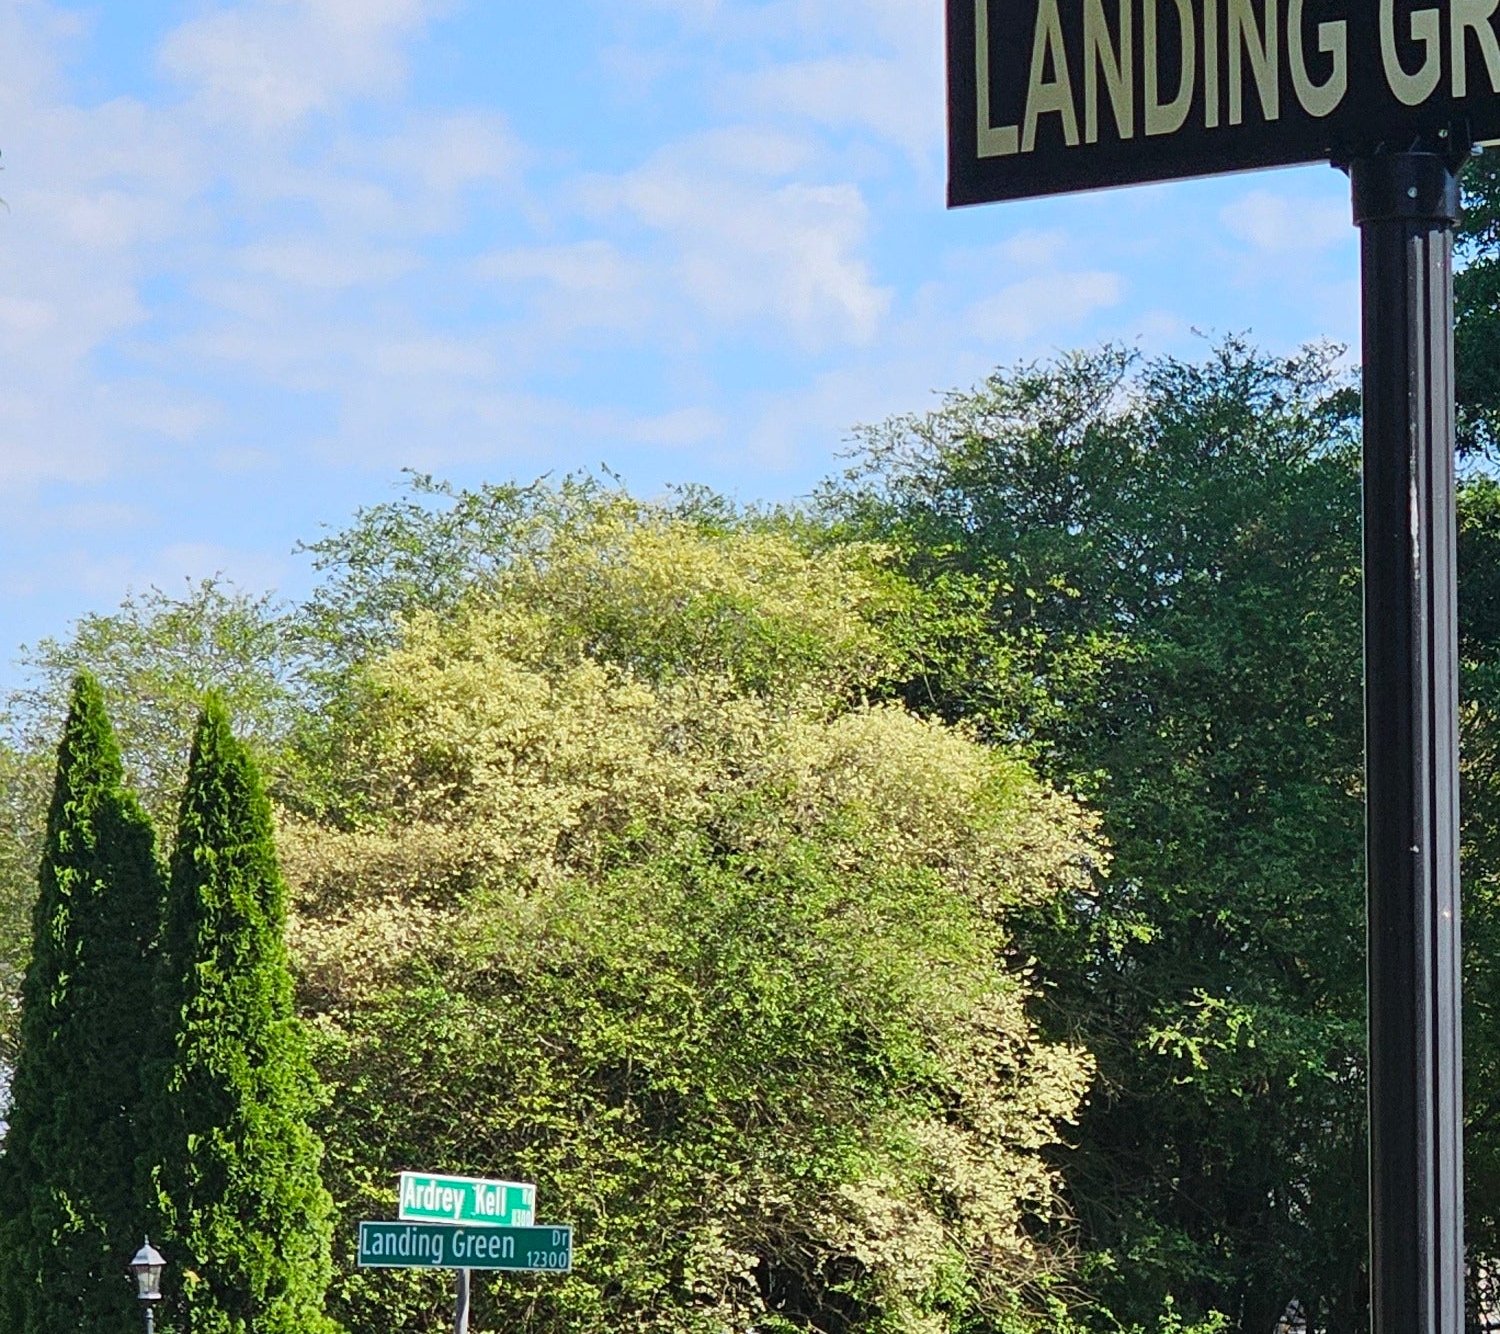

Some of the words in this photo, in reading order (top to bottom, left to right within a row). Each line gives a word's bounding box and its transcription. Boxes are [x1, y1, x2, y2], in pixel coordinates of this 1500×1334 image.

[404, 1177, 465, 1219] Ardrey
[475, 1186, 507, 1217] Kell
[362, 1228, 443, 1264] Landing
[452, 1230, 515, 1259] Green
[552, 1230, 567, 1246] Dr
[526, 1251, 567, 1267] 12300
